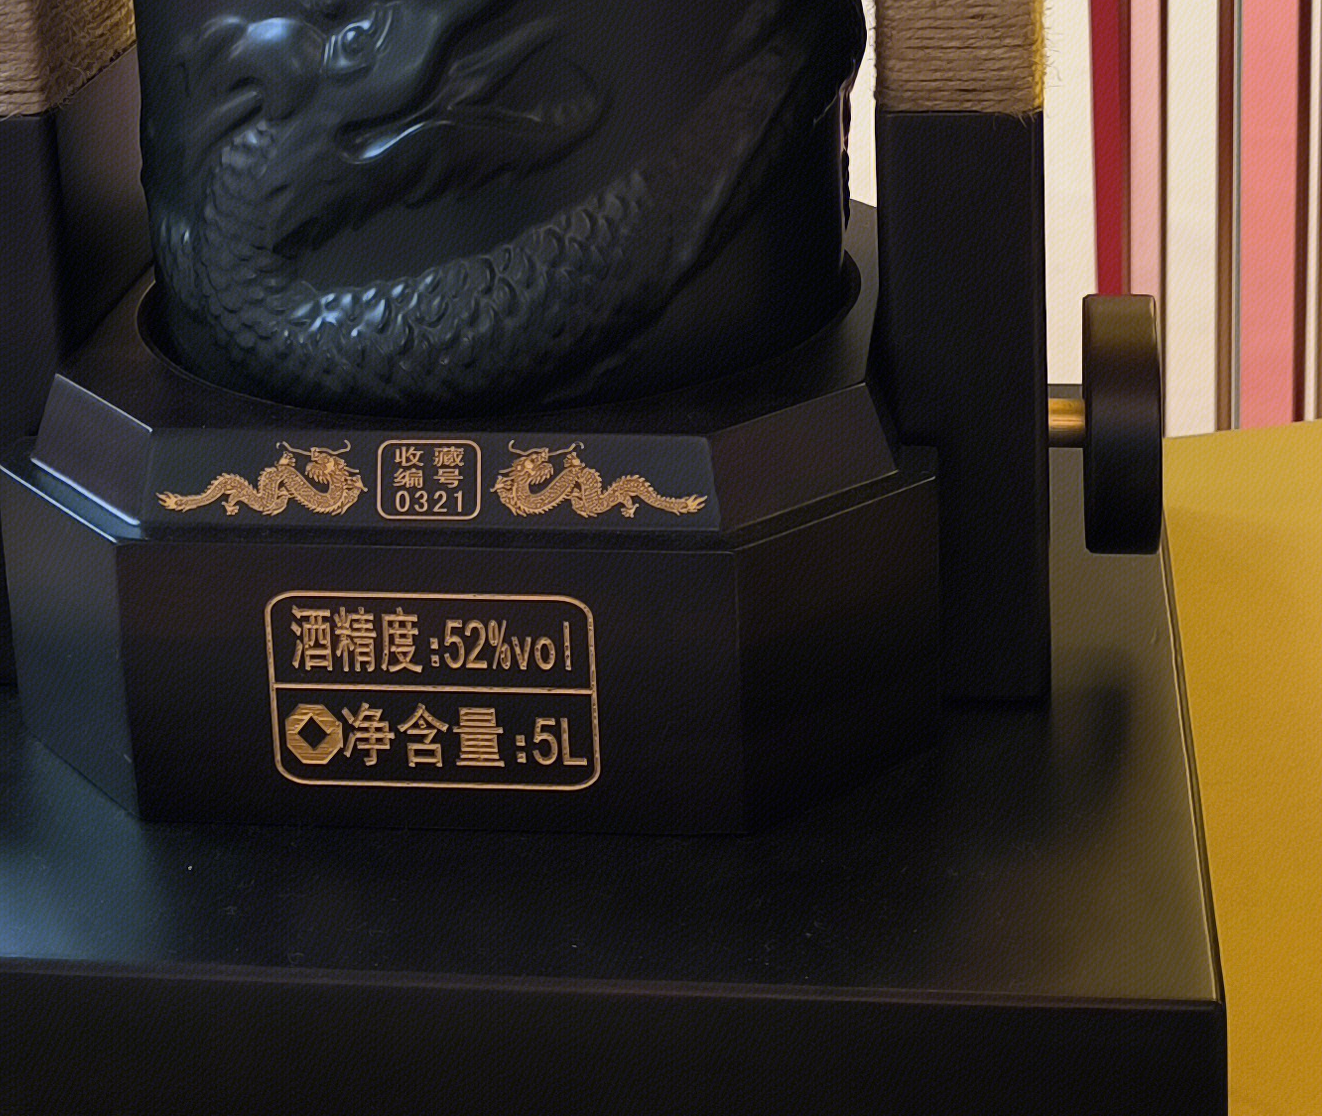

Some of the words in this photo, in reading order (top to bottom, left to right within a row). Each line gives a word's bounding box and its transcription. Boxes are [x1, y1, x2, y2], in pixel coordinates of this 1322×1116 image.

[393, 445, 465, 467] 收藏
[392, 467, 464, 489] 编号
[394, 489, 463, 513] 0321
